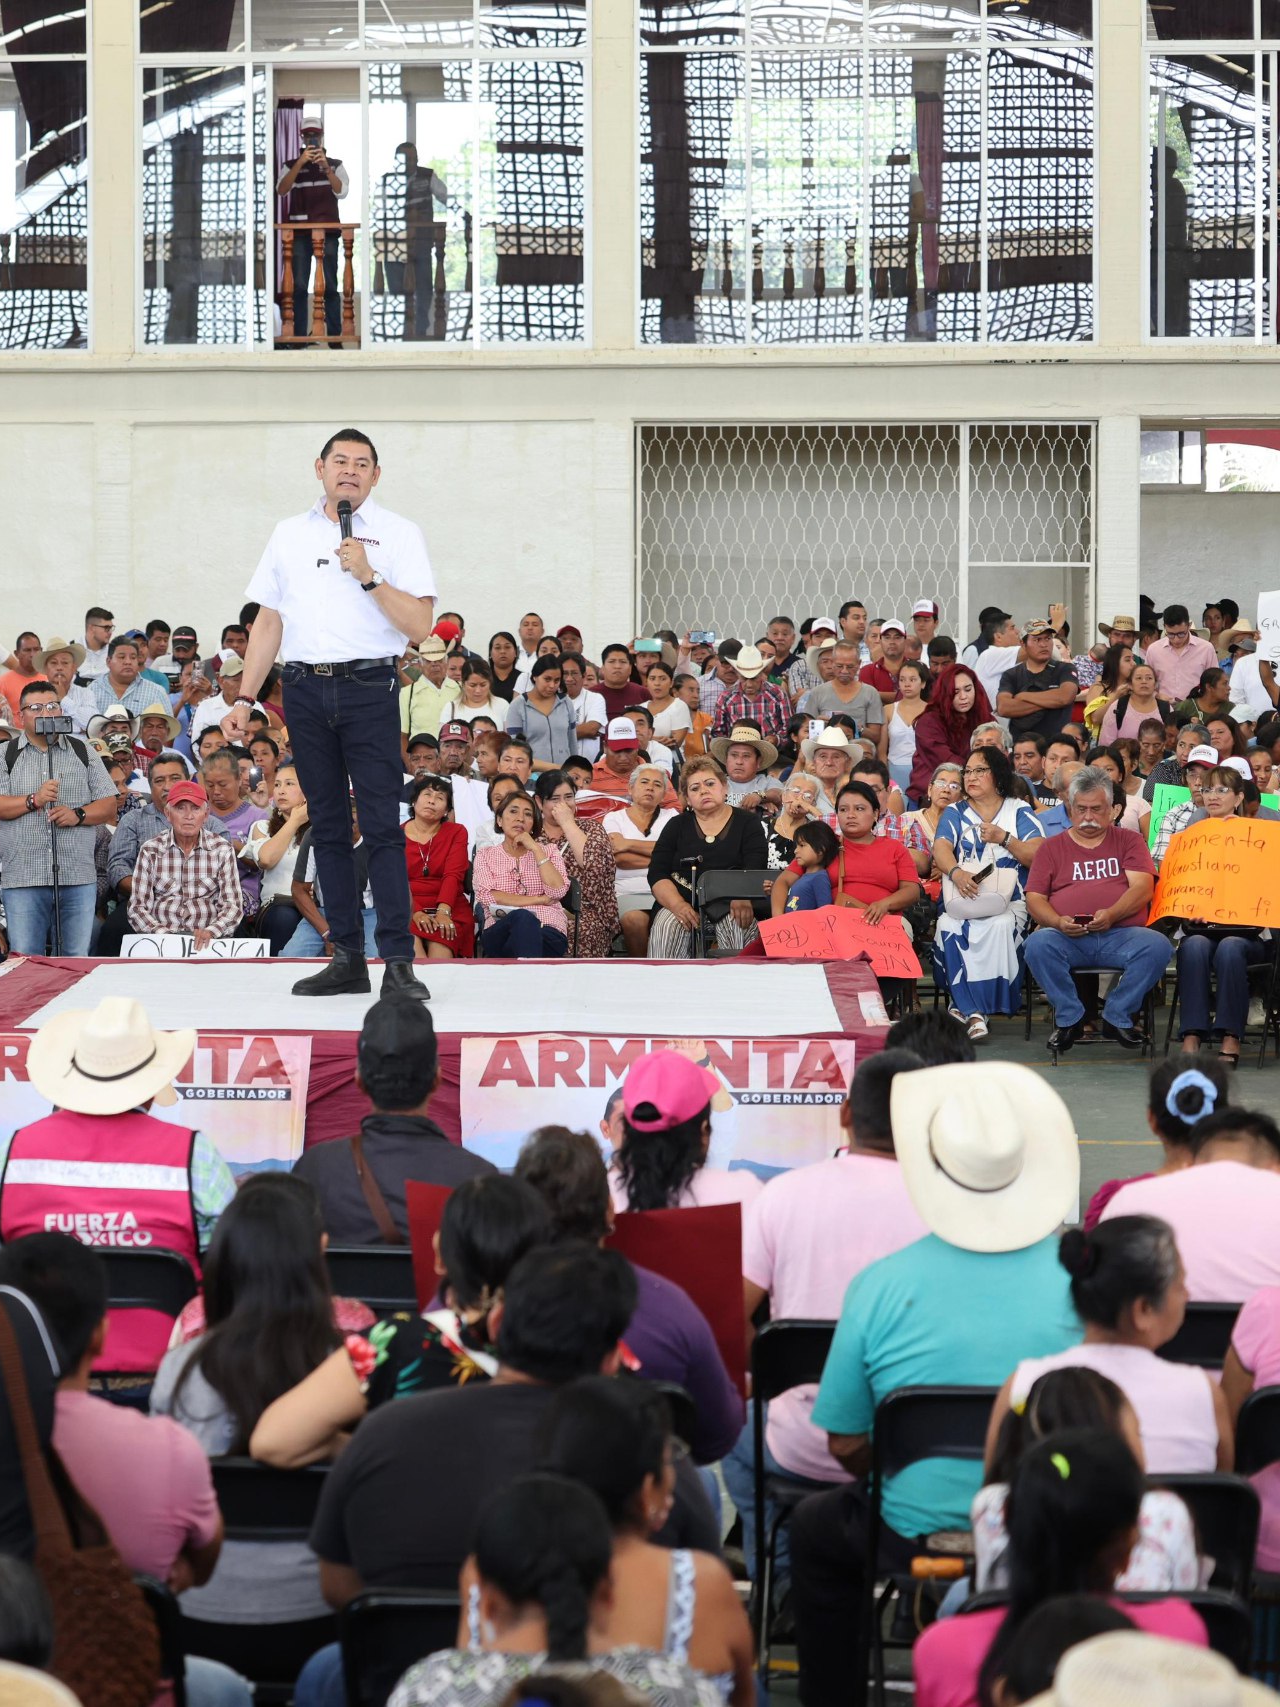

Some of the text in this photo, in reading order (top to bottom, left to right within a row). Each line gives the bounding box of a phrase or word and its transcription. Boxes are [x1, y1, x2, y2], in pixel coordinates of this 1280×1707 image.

[353, 536, 380, 546] RMENTA
[1171, 826, 1267, 856] Armenta
[1072, 857, 1120, 881] AERO
[1166, 852, 1241, 879] Venustiano
[478, 1039, 848, 1089] ARMNTA
[185, 1088, 287, 1100] GOBERNADOR
[740, 1092, 844, 1104] GOBERNADOR
[43, 1211, 138, 1233] FUERZA
[64, 1230, 153, 1247] XICO
